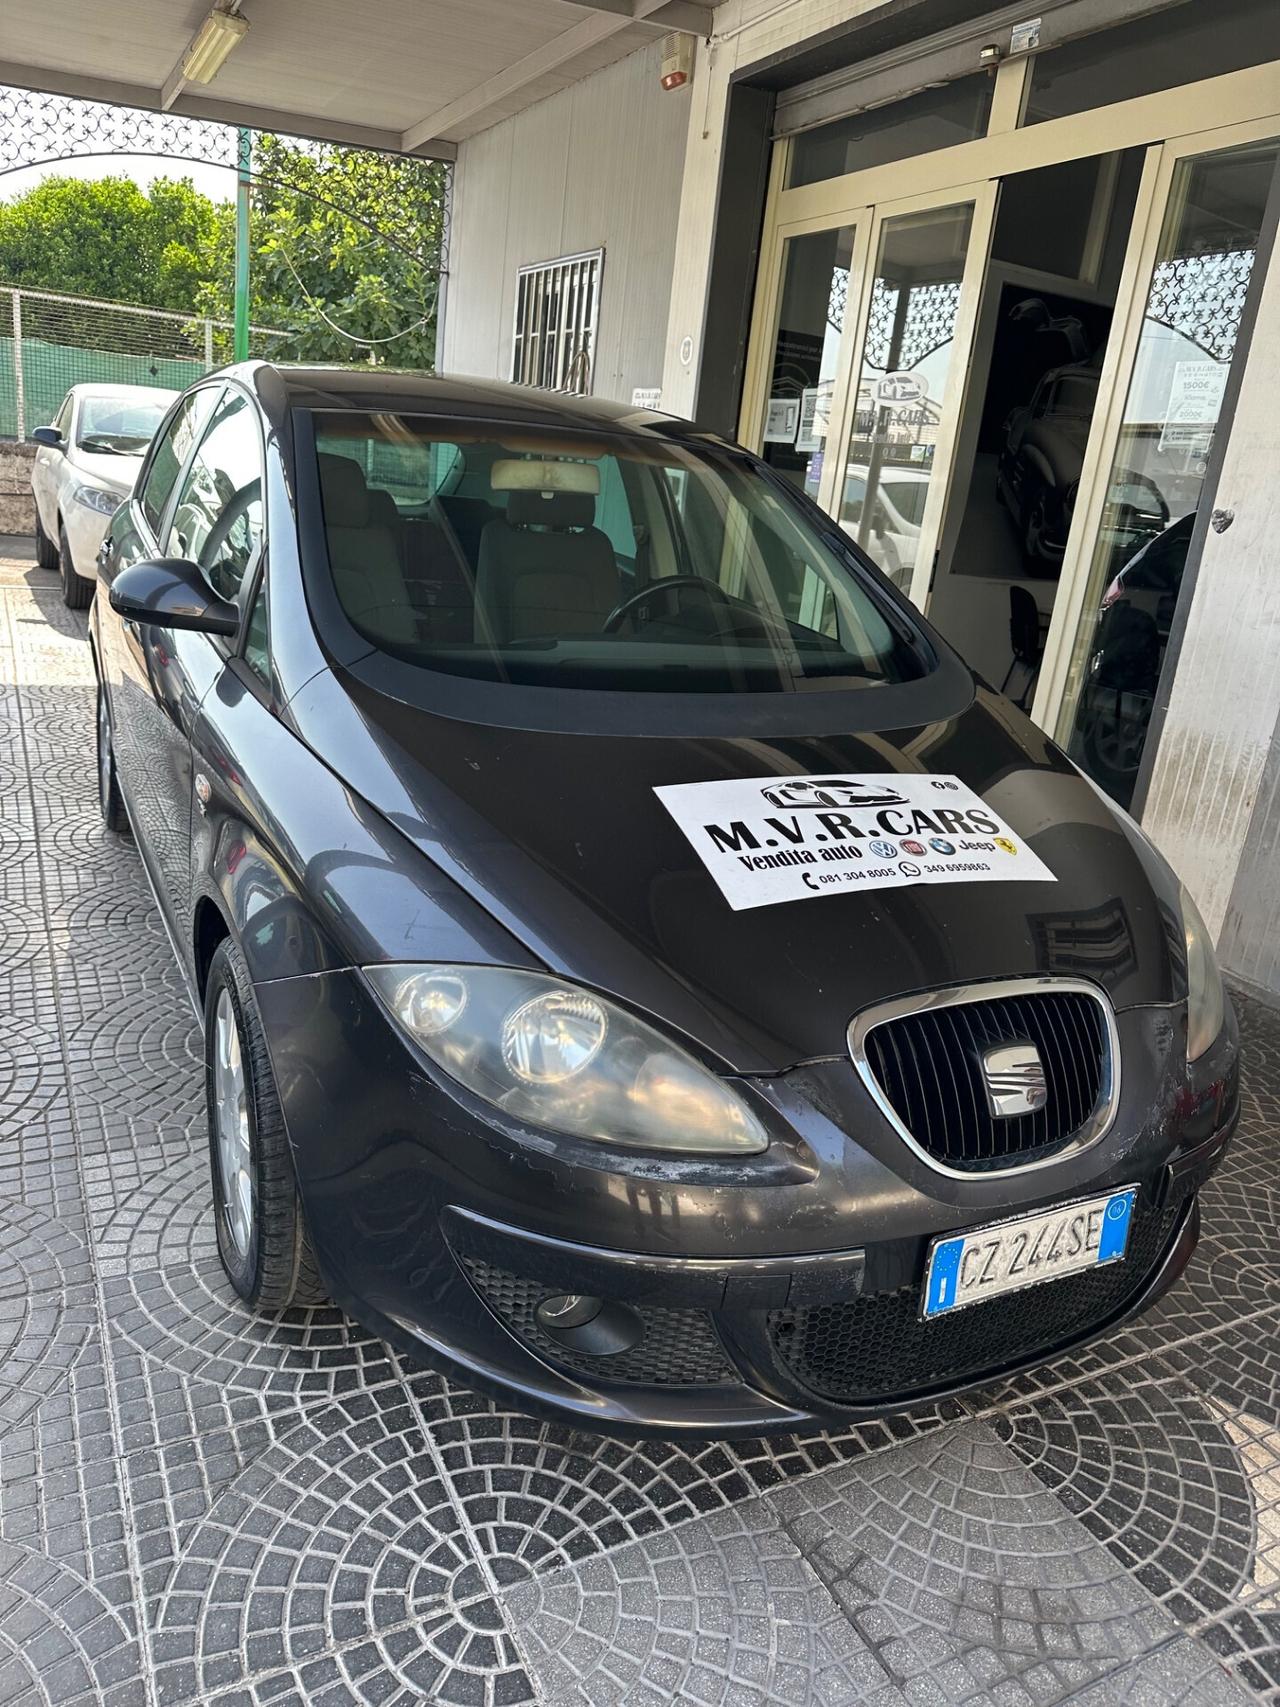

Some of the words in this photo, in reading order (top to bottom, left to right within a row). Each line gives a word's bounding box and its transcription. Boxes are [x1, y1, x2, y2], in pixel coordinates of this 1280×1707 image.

[959, 839, 995, 852] Jeep
[738, 848, 818, 872] Vendita
[818, 845, 863, 862] auto
[819, 874, 842, 884] 081
[844, 871, 866, 881] 304
[867, 868, 896, 878] 8005
[960, 1240, 1001, 1288] CZ
